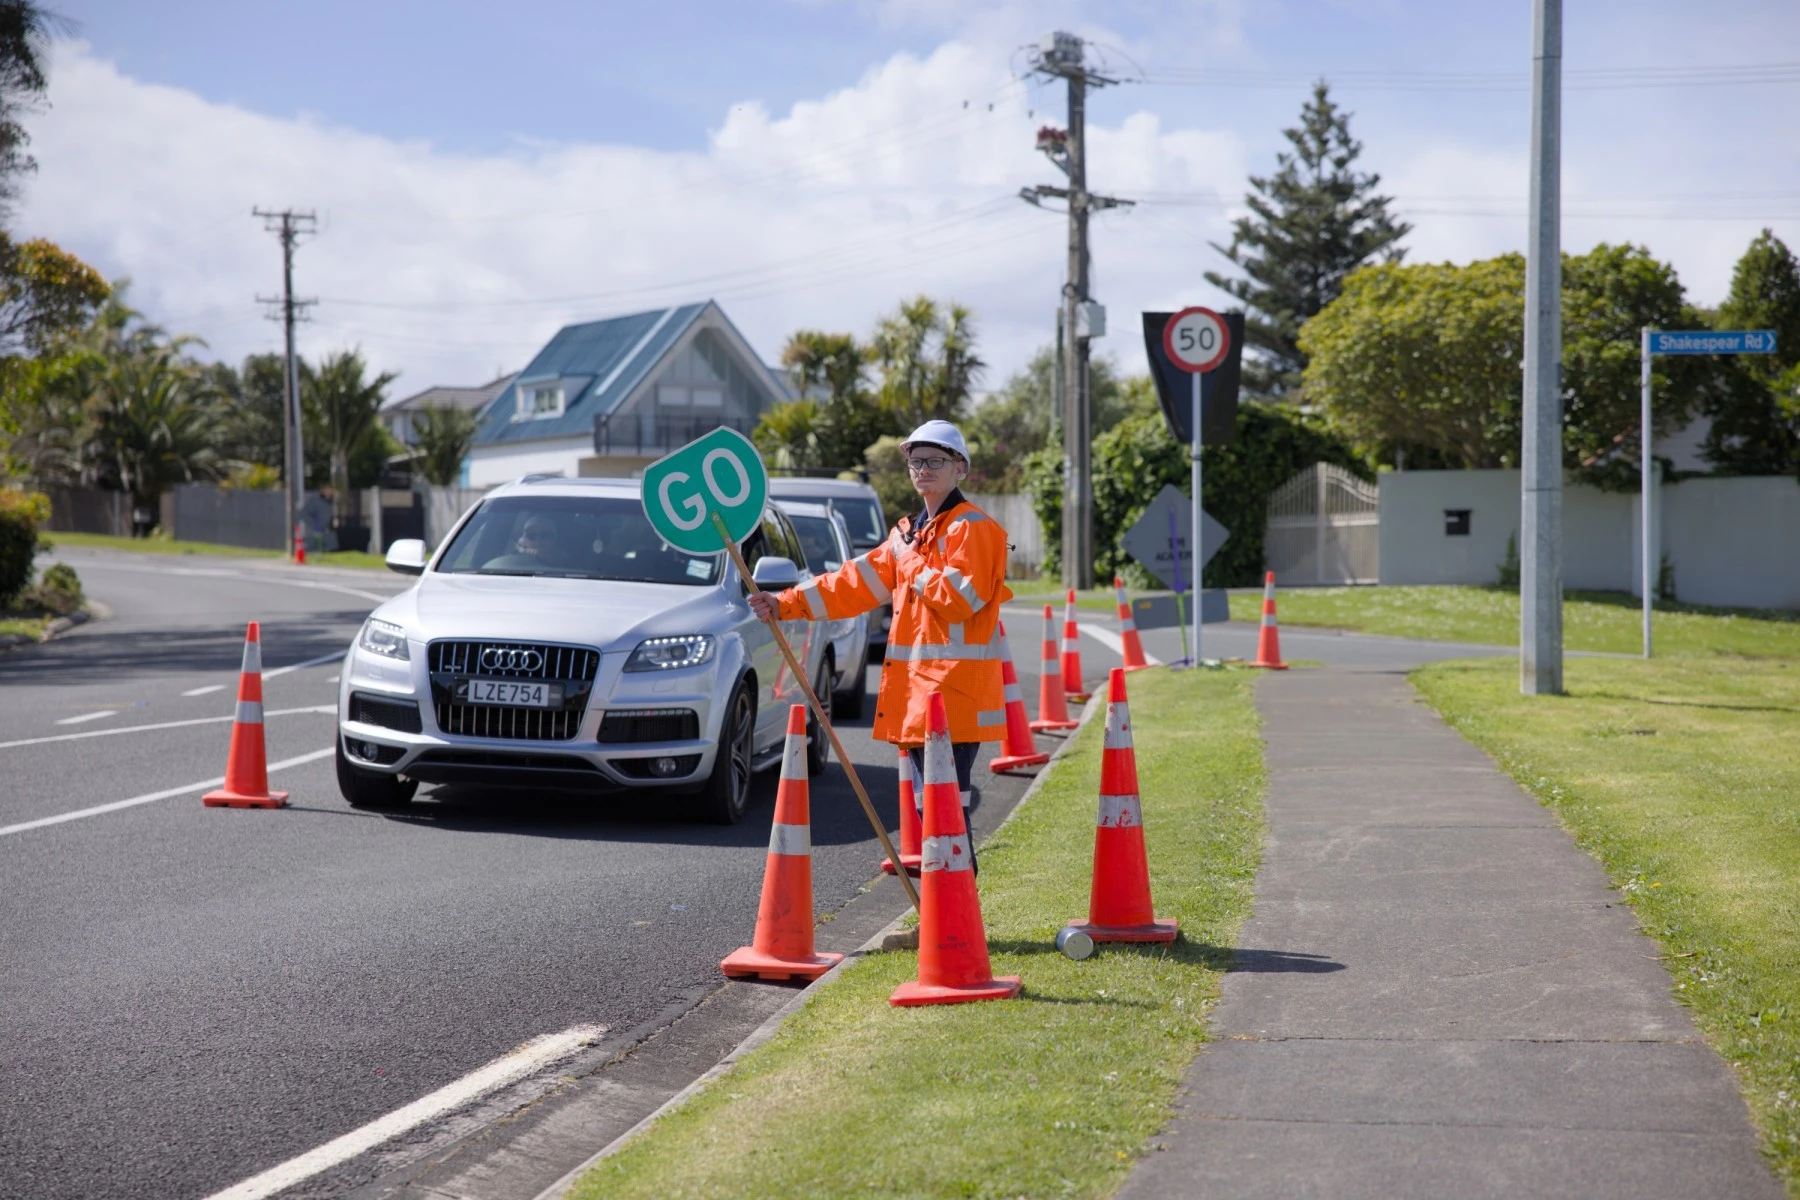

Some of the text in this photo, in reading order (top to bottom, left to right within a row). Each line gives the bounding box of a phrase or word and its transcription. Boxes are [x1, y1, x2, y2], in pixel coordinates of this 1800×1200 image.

[1180, 327, 1215, 351] 50
[1658, 333, 1763, 352] Shakespear Rd
[658, 447, 751, 532] GO
[474, 682, 542, 704] LZE754
